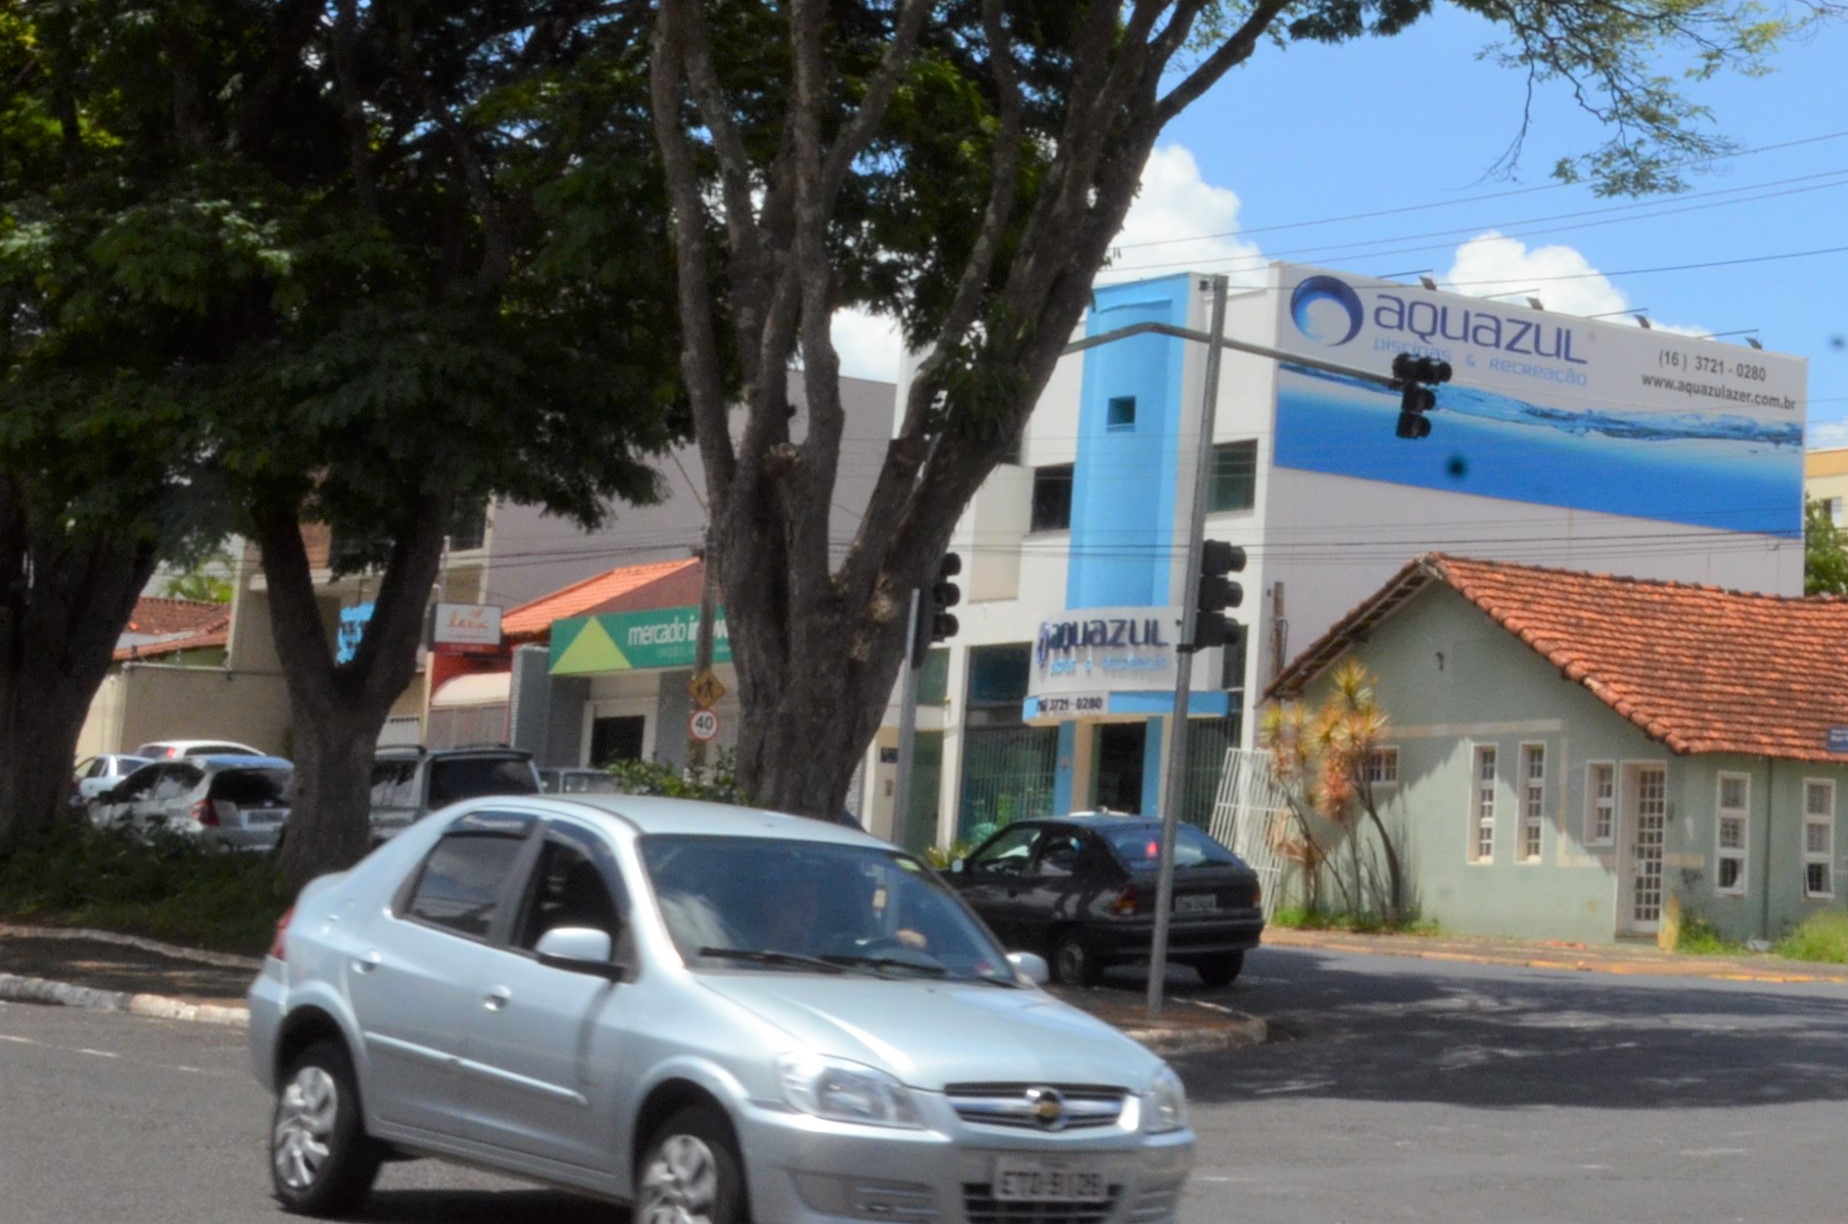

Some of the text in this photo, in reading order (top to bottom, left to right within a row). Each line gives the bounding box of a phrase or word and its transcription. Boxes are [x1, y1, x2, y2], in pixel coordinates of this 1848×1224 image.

[1465, 353, 1477, 368] &
[1641, 374, 1796, 410] www.aquazulazer.com.br
[628, 615, 687, 646] mercado
[695, 715, 713, 731] 40
